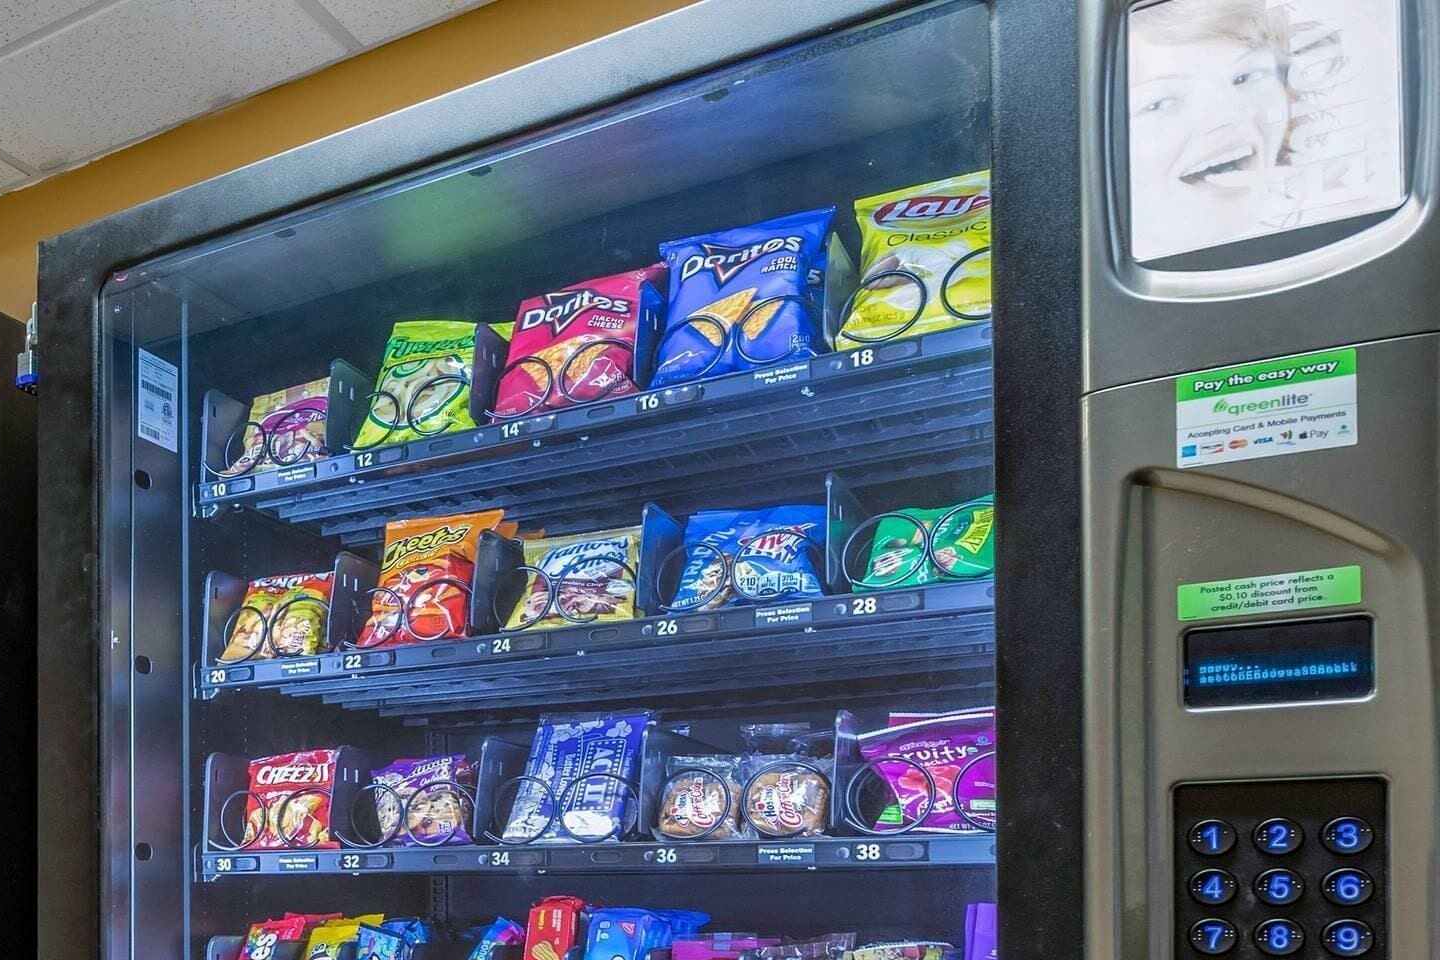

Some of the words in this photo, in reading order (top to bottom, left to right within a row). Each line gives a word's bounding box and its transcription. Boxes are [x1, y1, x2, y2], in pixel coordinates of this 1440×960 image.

[887, 220, 988, 248] Classic
[681, 236, 804, 282] Doritos
[761, 261, 798, 273] RANCH
[771, 256, 798, 267] COOL
[521, 290, 631, 332] Doritos
[588, 319, 625, 330] CHEESE
[591, 314, 626, 326] NACHO
[851, 349, 874, 366] 18
[776, 364, 809, 376] Selection
[1194, 378, 1224, 392] Pay
[1228, 374, 1254, 386] the
[1258, 368, 1297, 382] easy
[1301, 361, 1340, 374] way
[640, 395, 659, 410] 16
[1228, 392, 1309, 415] greenlite
[502, 424, 519, 439] 14
[1187, 425, 1231, 439] Accepting
[1233, 423, 1256, 433] Card
[1267, 417, 1298, 428] Mobile
[1300, 410, 1347, 423] Payments
[1253, 436, 1274, 445] VISA
[1309, 430, 1330, 440] Pay
[357, 453, 373, 468] 12
[211, 484, 226, 497] 10
[381, 525, 470, 569] Cheetos
[538, 534, 630, 568] Famous
[740, 577, 757, 587] 210
[1200, 584, 1231, 594] Posted
[1234, 581, 1258, 590] cash
[1259, 579, 1285, 590] price
[1288, 574, 1324, 584] reflects
[1219, 592, 1248, 602] $0.10
[1250, 588, 1292, 598] discount
[1294, 585, 1318, 593] from
[853, 598, 877, 615] 28
[1211, 599, 1269, 612] credit/debit
[1271, 597, 1295, 606] card
[1297, 594, 1326, 605] price.
[657, 620, 678, 636] 26
[493, 639, 511, 653] 24
[345, 655, 362, 668] 22
[211, 670, 226, 682] 20
[562, 753, 576, 776] Butter
[1202, 825, 1218, 850] 1
[1268, 824, 1289, 848] 2
[1336, 823, 1359, 848] 3
[492, 851, 510, 866] 34
[656, 849, 677, 863] 36
[856, 844, 881, 860] 38
[216, 858, 231, 871] 30
[343, 855, 359, 868] 32
[1204, 875, 1222, 899] 4
[1270, 875, 1291, 899] 5
[1338, 876, 1360, 899] 6
[1204, 926, 1224, 950] 7
[1270, 926, 1289, 949] 8
[1338, 927, 1359, 950] 9
